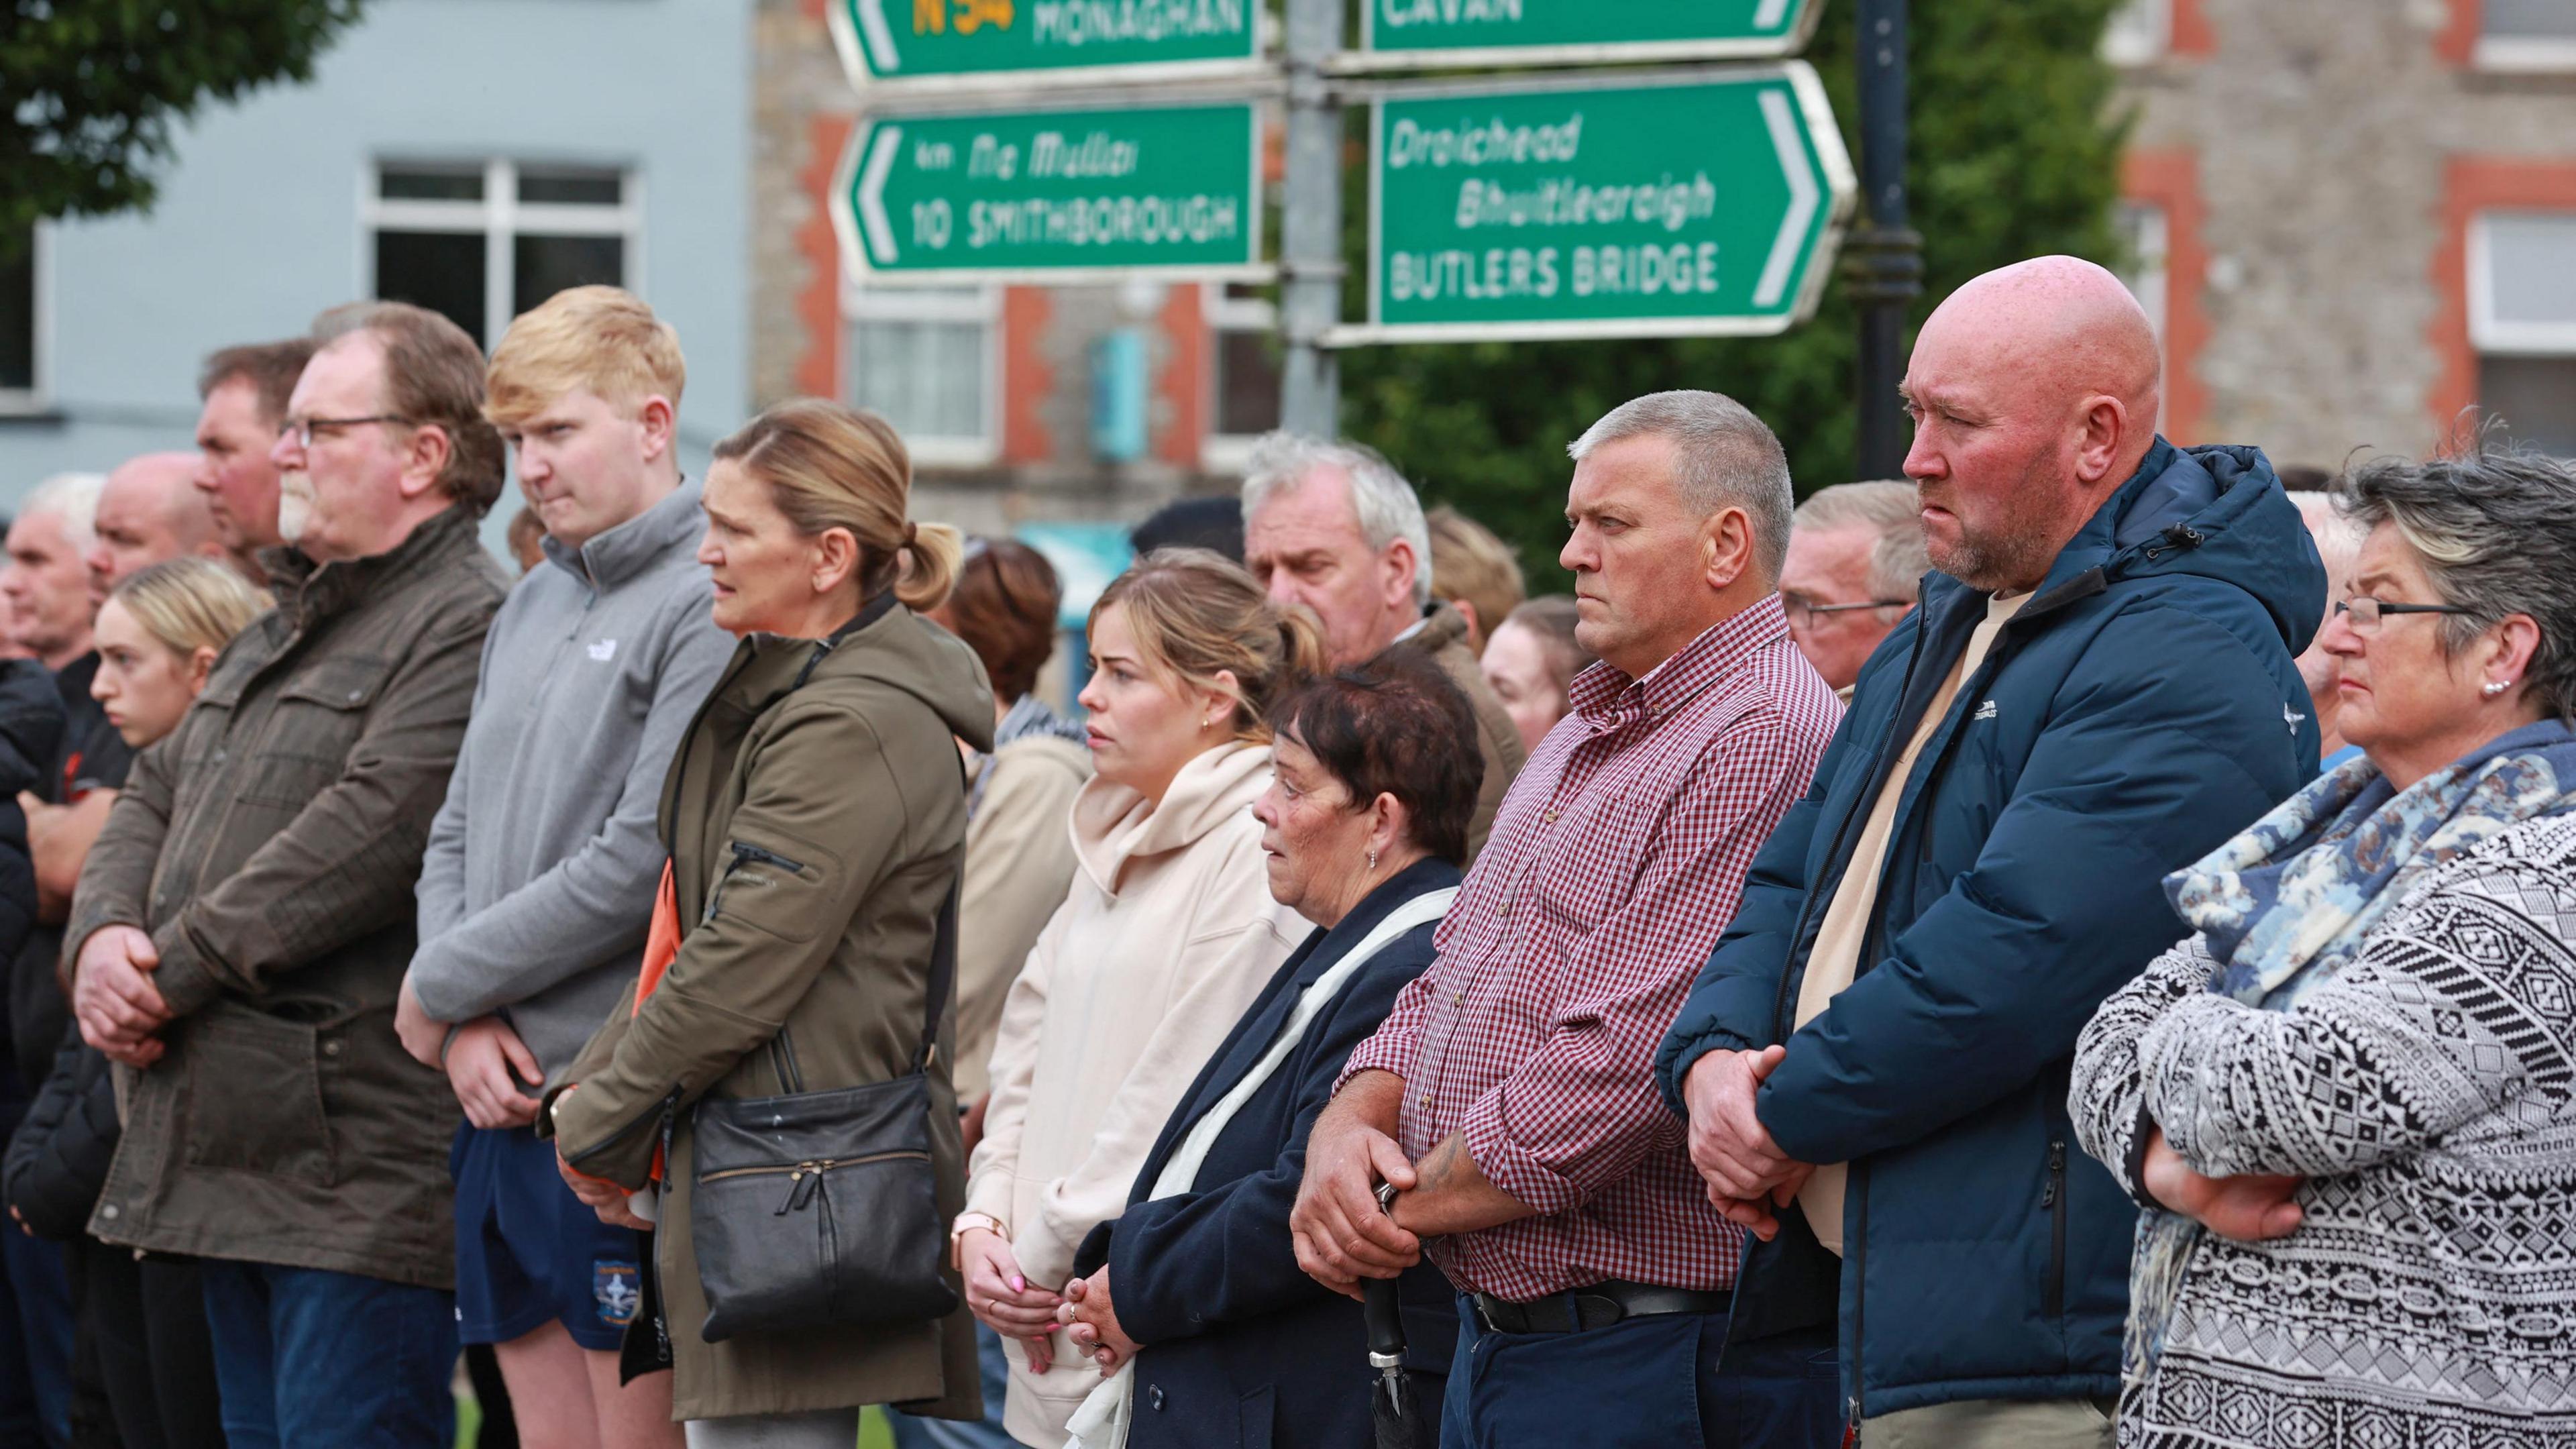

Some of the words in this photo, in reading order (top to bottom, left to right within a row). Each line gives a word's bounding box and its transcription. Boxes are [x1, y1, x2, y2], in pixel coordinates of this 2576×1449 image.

[1033, 0, 1243, 45] MONAGHAN
[914, 138, 954, 170] km
[967, 133, 1018, 180] Na
[1389, 111, 1583, 168] Droichead
[911, 198, 953, 249] 10
[967, 193, 1238, 249] SMITHBOROUGH
[1454, 170, 1716, 232] Bhuitlearaigh
[1390, 247, 1560, 301] BUTLERS
[1572, 241, 1720, 297] BRIDGE
